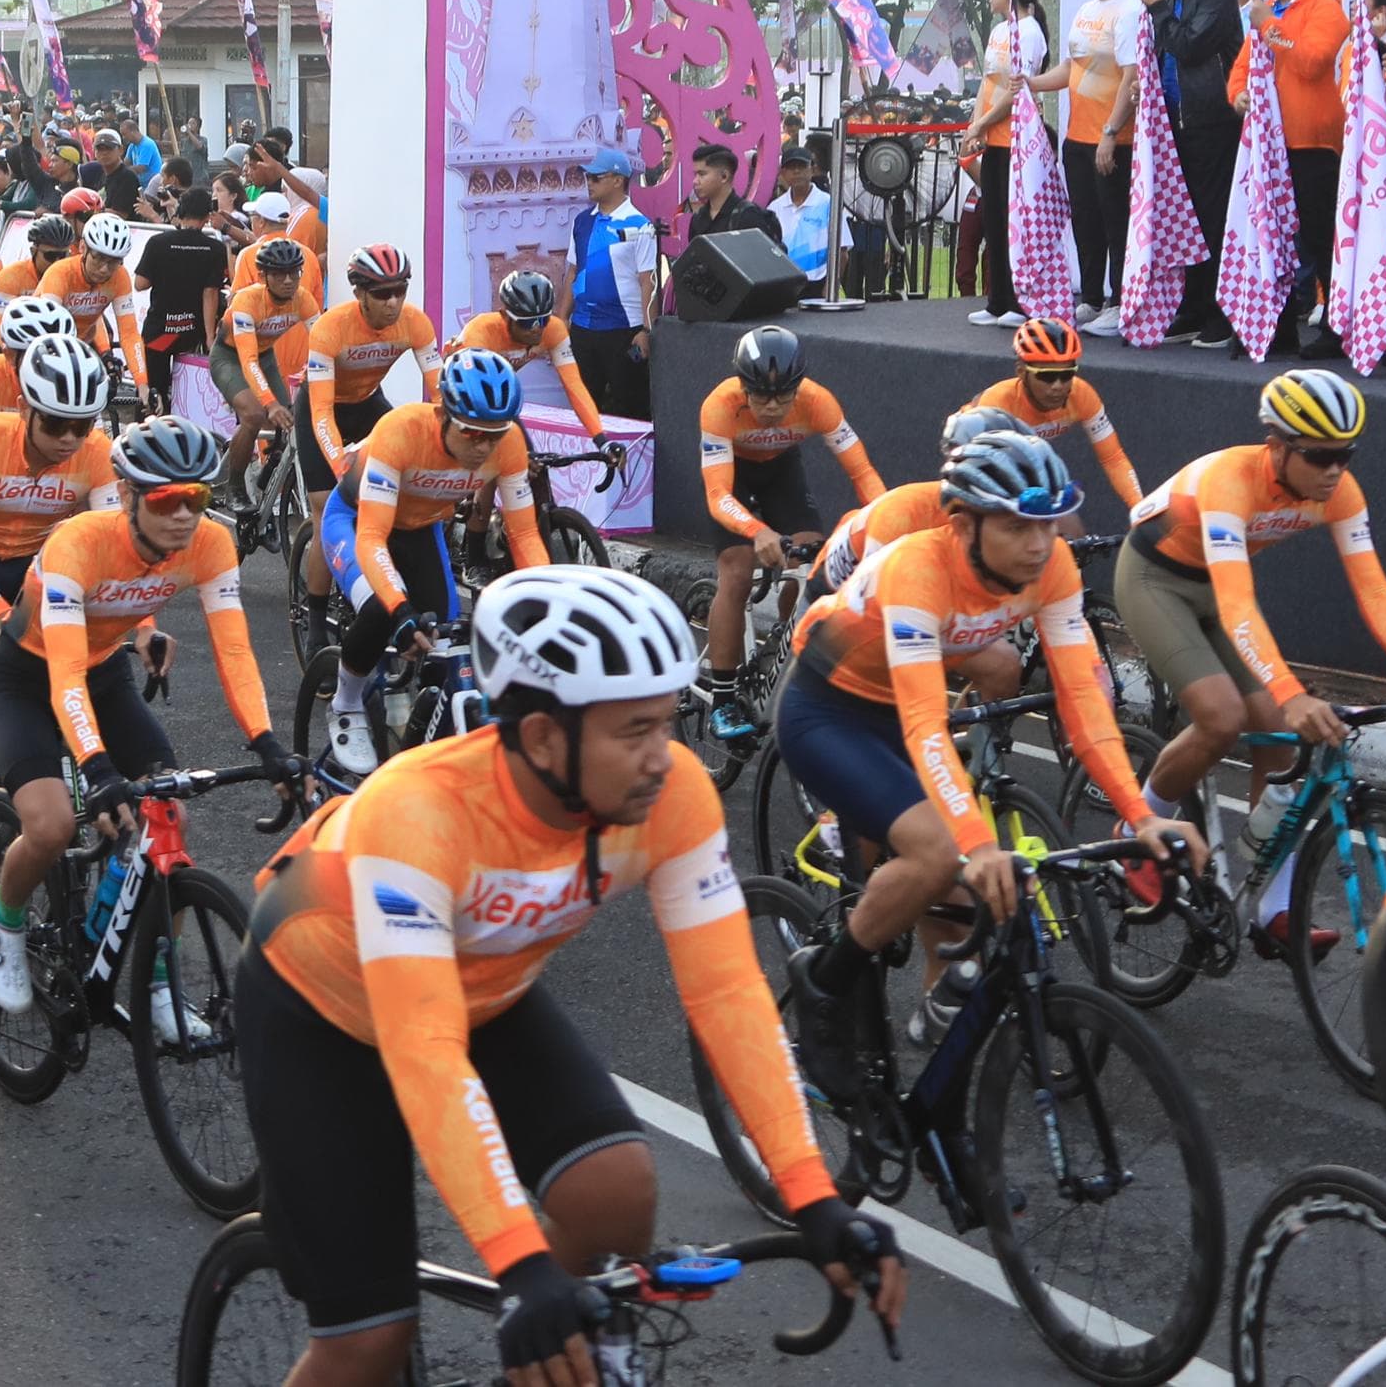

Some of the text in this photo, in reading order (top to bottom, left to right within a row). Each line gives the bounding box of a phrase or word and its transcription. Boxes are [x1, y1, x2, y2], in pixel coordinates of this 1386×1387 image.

[412, 471, 485, 491] Kemala
[63, 687, 101, 753] Kemala
[922, 732, 971, 818] Kemala
[89, 818, 156, 980] TREK
[463, 1075, 527, 1210] Kemala
